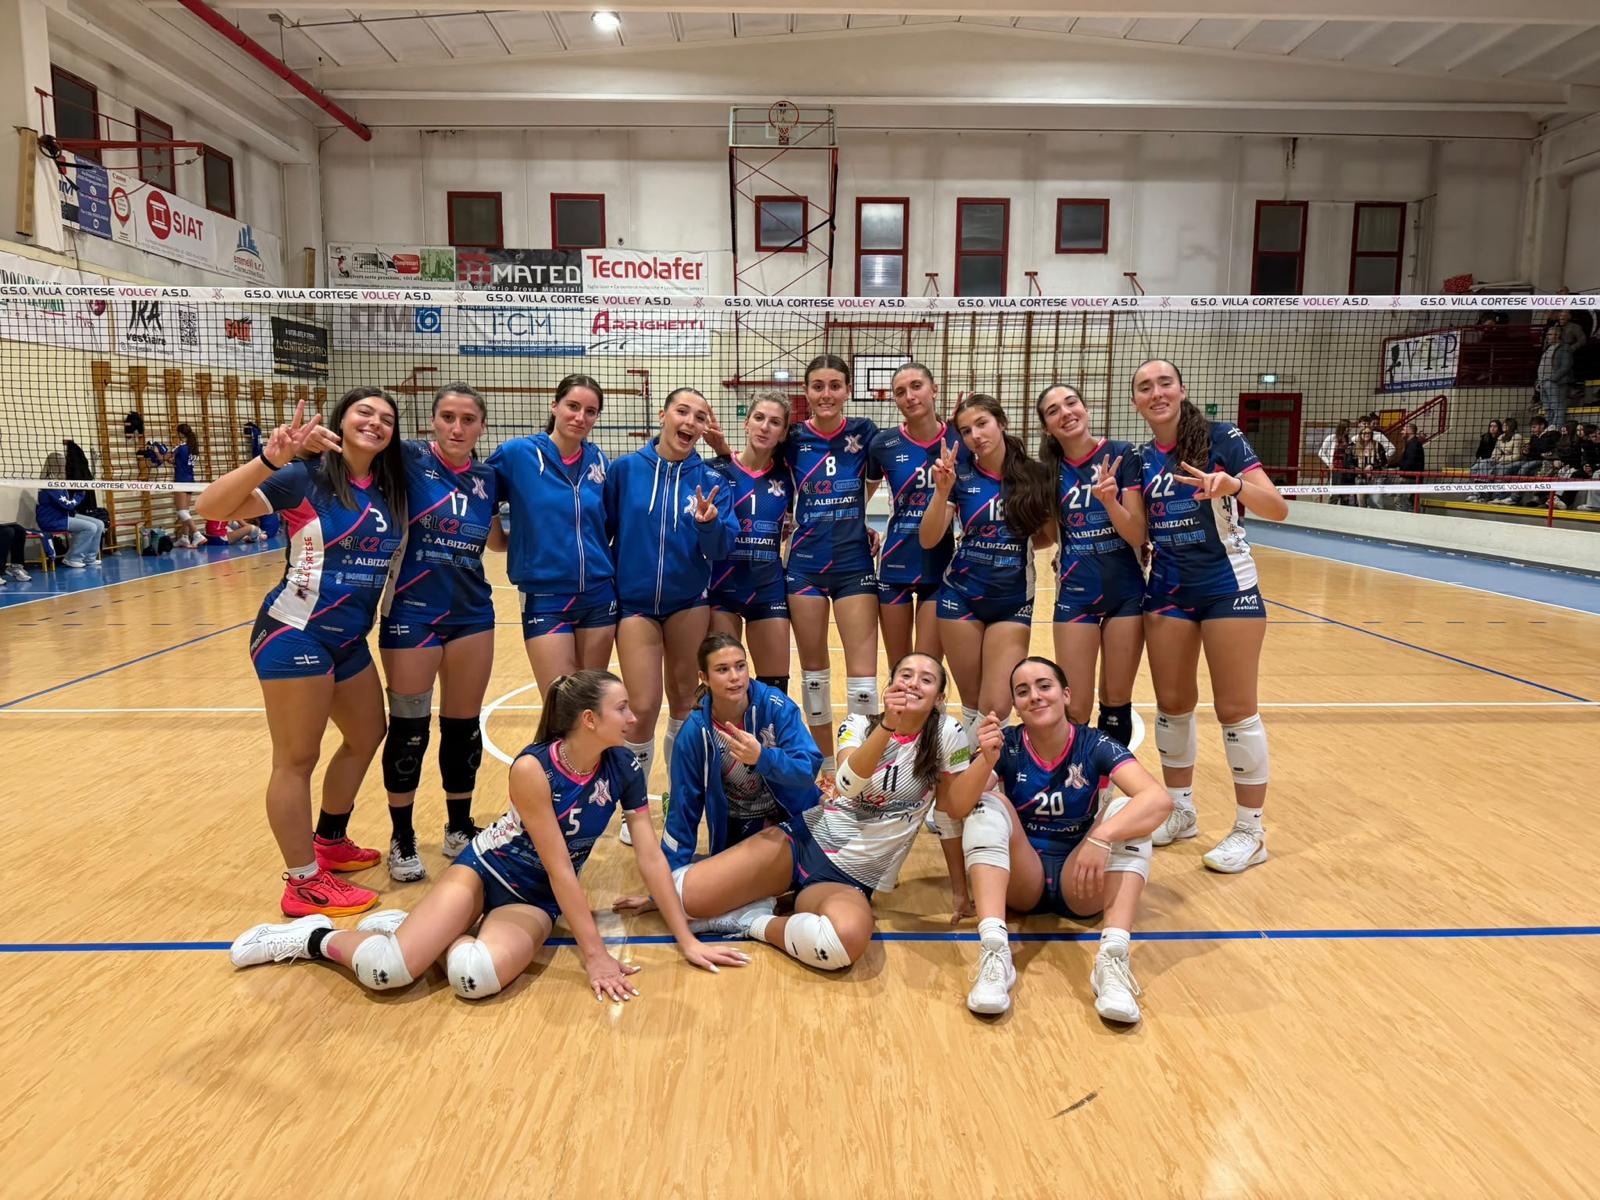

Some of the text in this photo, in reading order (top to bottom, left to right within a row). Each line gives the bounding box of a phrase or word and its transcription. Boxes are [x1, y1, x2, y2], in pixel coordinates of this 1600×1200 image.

[173, 211, 203, 241] SIAT
[586, 255, 703, 280] Tecnolafer
[0, 286, 192, 298] G.S.O. VILLA CORTESE VOLLEY A.S.D.
[244, 290, 433, 300] G.S.O. VILLA CORTESE VOLLEY A.S.D.
[486, 294, 673, 305] G.S.O. VILLA CORTESE VOLLEY A.S.D.
[725, 298, 753, 306] G.S.O.
[756, 298, 783, 307] VILLA
[787, 298, 834, 307] CORTESE
[838, 298, 876, 307] VOLLEY
[957, 298, 1139, 307] G.S.O. VILLA CORTESE VOLLEY A.S.D.
[1190, 297, 1370, 306] G.S.O. VILLA CORTESE VOLLEY A.S.D.
[1420, 297, 1596, 306] G.S.O. VILLA CORTESE VOLLEY A.S.D.
[825, 456, 837, 477] 8
[1151, 472, 1175, 499] 22
[450, 491, 468, 517] 17
[750, 494, 756, 515] 1
[1069, 484, 1092, 509] 27
[369, 508, 388, 532] 3
[1154, 518, 1194, 528] ALBIZZATI
[434, 537, 480, 552] ALBIZZATI
[882, 764, 899, 792] 11
[1034, 791, 1065, 816] 20
[565, 808, 583, 836] 5
